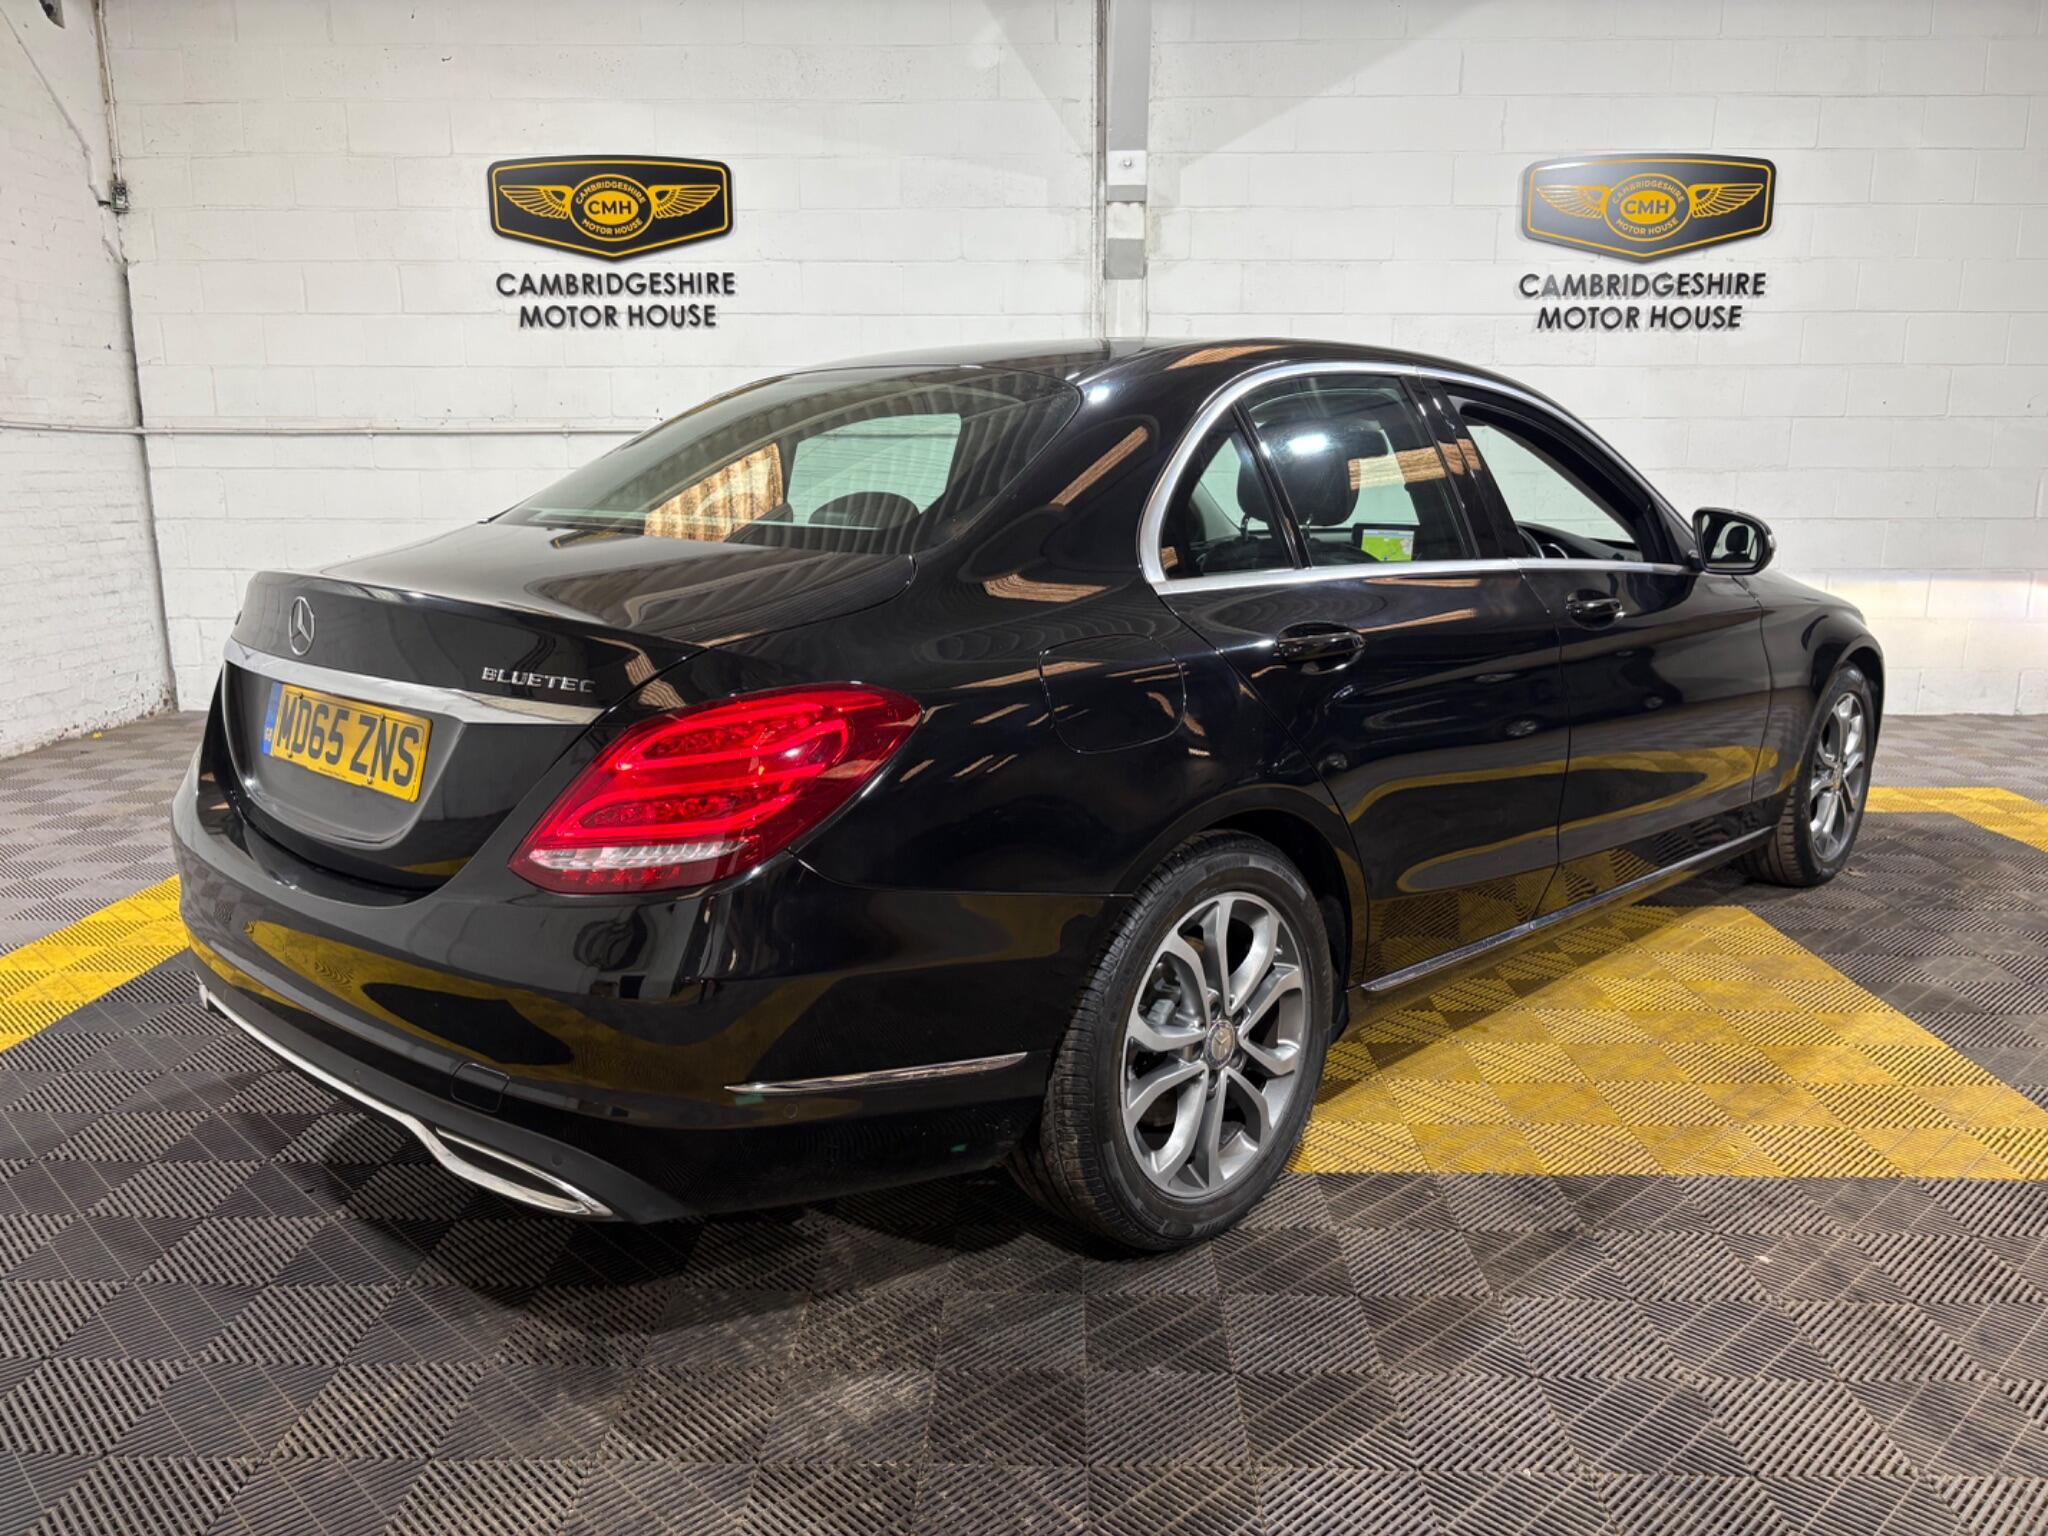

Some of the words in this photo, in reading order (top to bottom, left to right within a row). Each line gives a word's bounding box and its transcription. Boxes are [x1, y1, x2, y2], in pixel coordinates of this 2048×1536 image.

[576, 181, 646, 204] CAMBRIDGESHIRE
[1612, 180, 1685, 204] CAMBRIDGESHIRE
[588, 200, 632, 215] CMH
[1624, 199, 1670, 215] CMH
[582, 218, 613, 235] MOTOR
[614, 218, 643, 235] HOUSE
[1616, 218, 1646, 235] MOTOR
[1648, 217, 1679, 234] HOUSE
[496, 272, 736, 297] CAMBRIDGESHIRE
[1519, 272, 1767, 298] CAMBRIDGESHIRE
[519, 305, 618, 328] MOTOR
[628, 304, 717, 328] HOUSE
[1537, 306, 1640, 330] MOTOR
[1650, 305, 1743, 329] HOUSE
[481, 667, 596, 693] BLUETEC
[276, 694, 350, 766] MD65
[350, 714, 420, 788] ZNS
